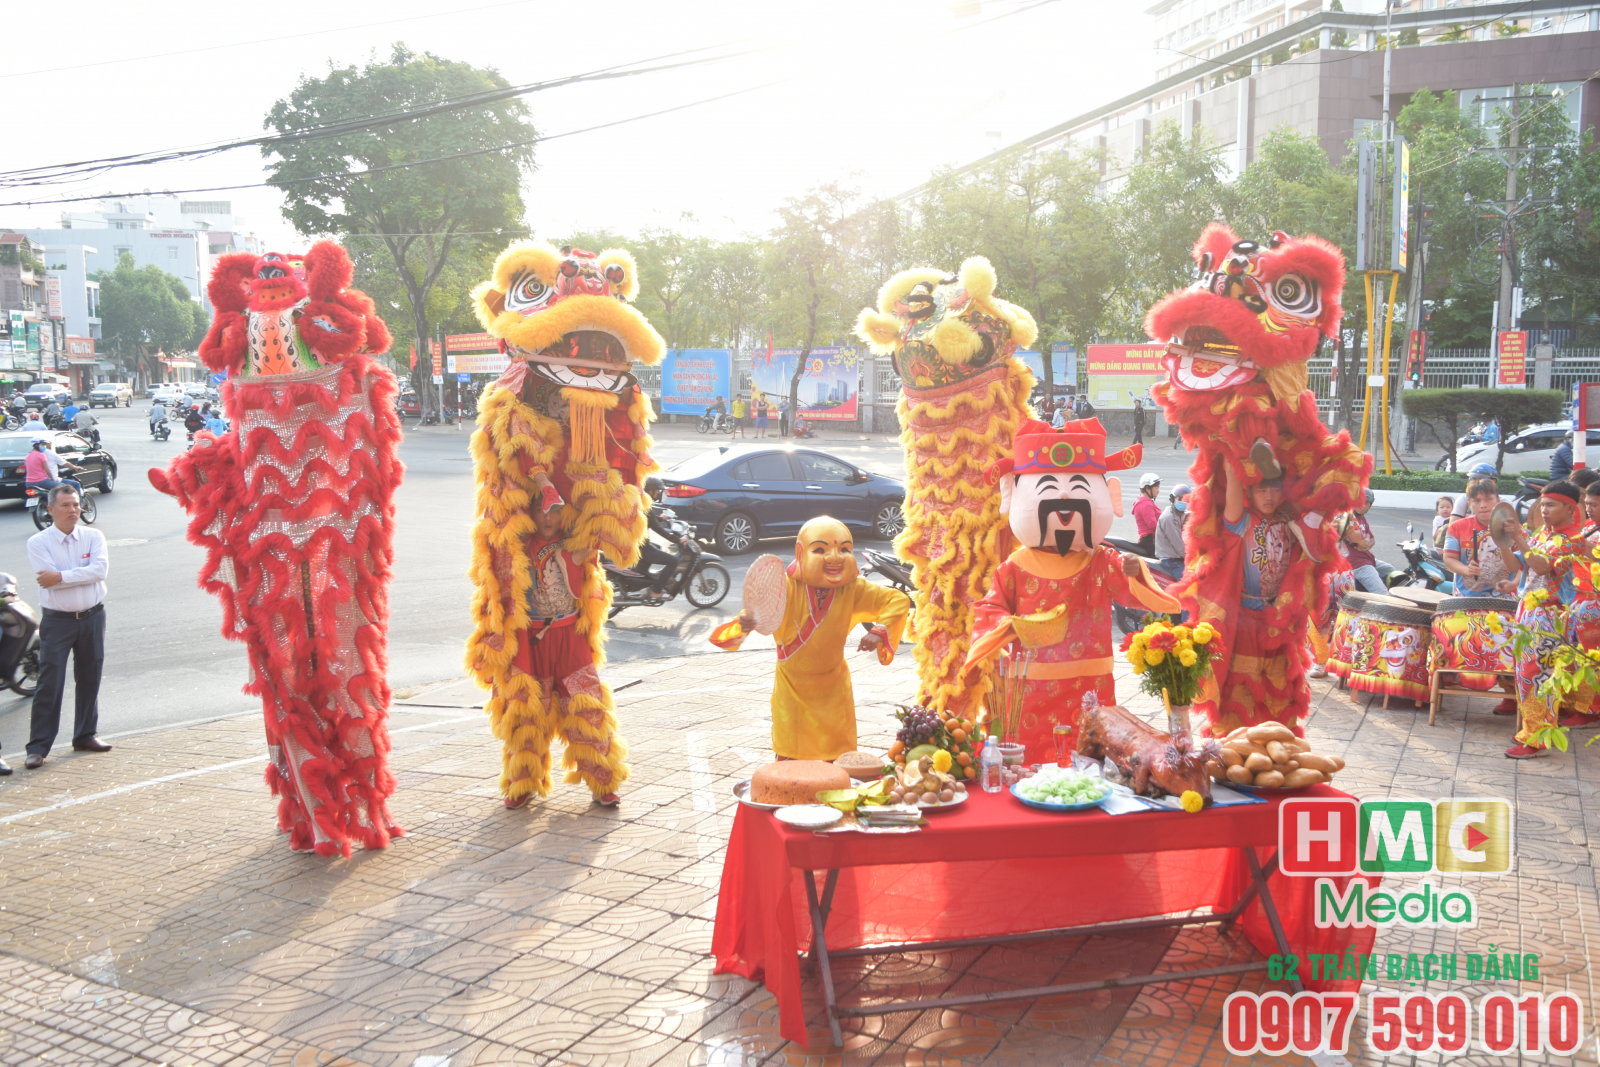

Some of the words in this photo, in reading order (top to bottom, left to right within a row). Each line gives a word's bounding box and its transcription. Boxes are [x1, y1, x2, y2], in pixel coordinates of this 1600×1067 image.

[1126, 349, 1143, 358] MỪNG
[1143, 348, 1154, 358] ĐẤT
[1090, 361, 1106, 370] MỪNG
[1106, 360, 1122, 370] ĐẢNG
[1122, 362, 1141, 371] QUANG
[1142, 362, 1156, 371] VINH,
